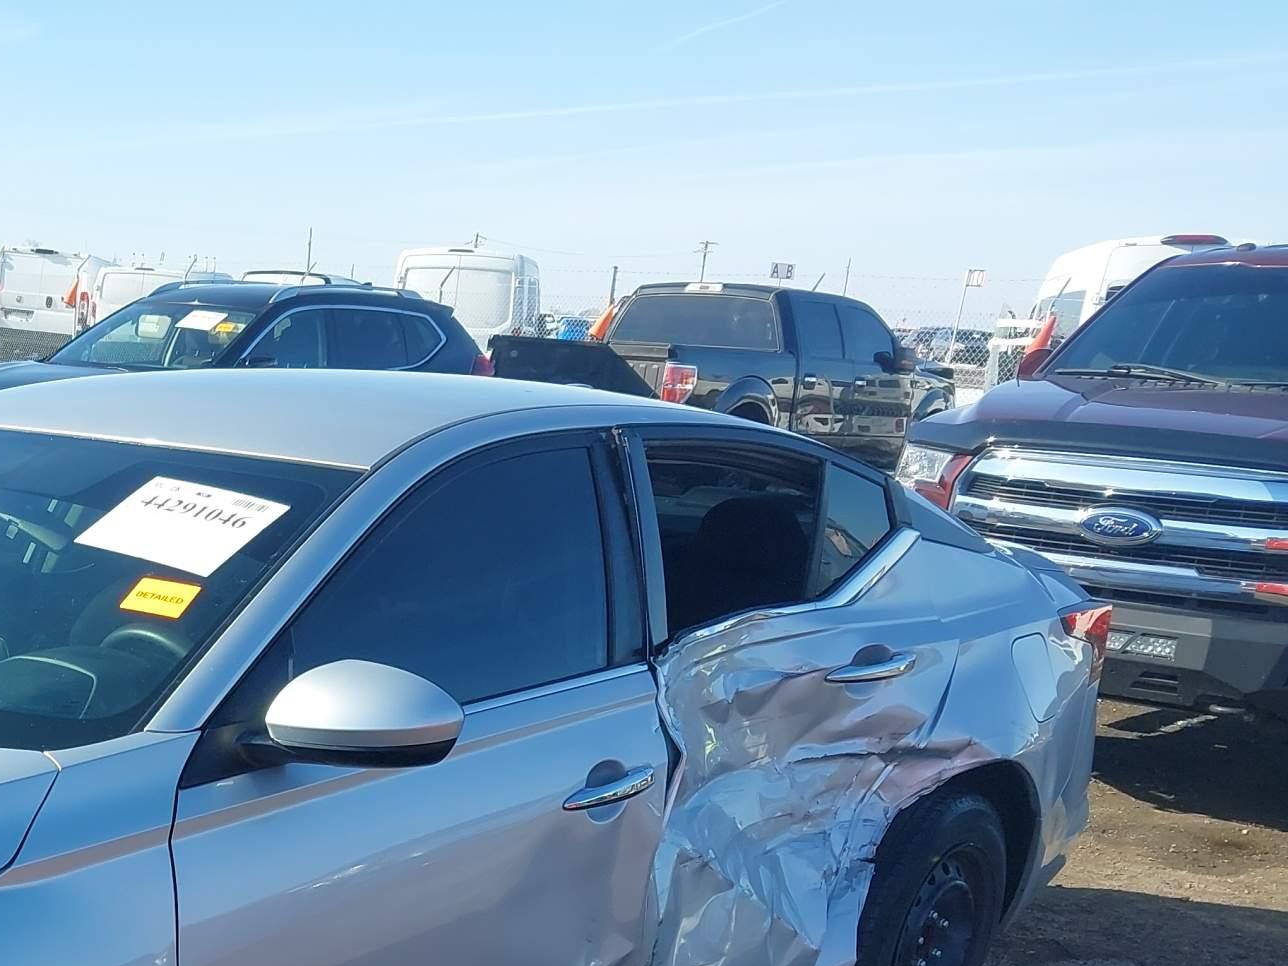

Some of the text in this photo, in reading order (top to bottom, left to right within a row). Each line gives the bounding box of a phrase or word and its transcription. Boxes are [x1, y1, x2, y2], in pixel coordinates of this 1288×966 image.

[770, 263, 794, 280] A B
[140, 495, 249, 529] 44291046
[1093, 515, 1139, 536] Ford
[136, 590, 184, 605] DETAILED
